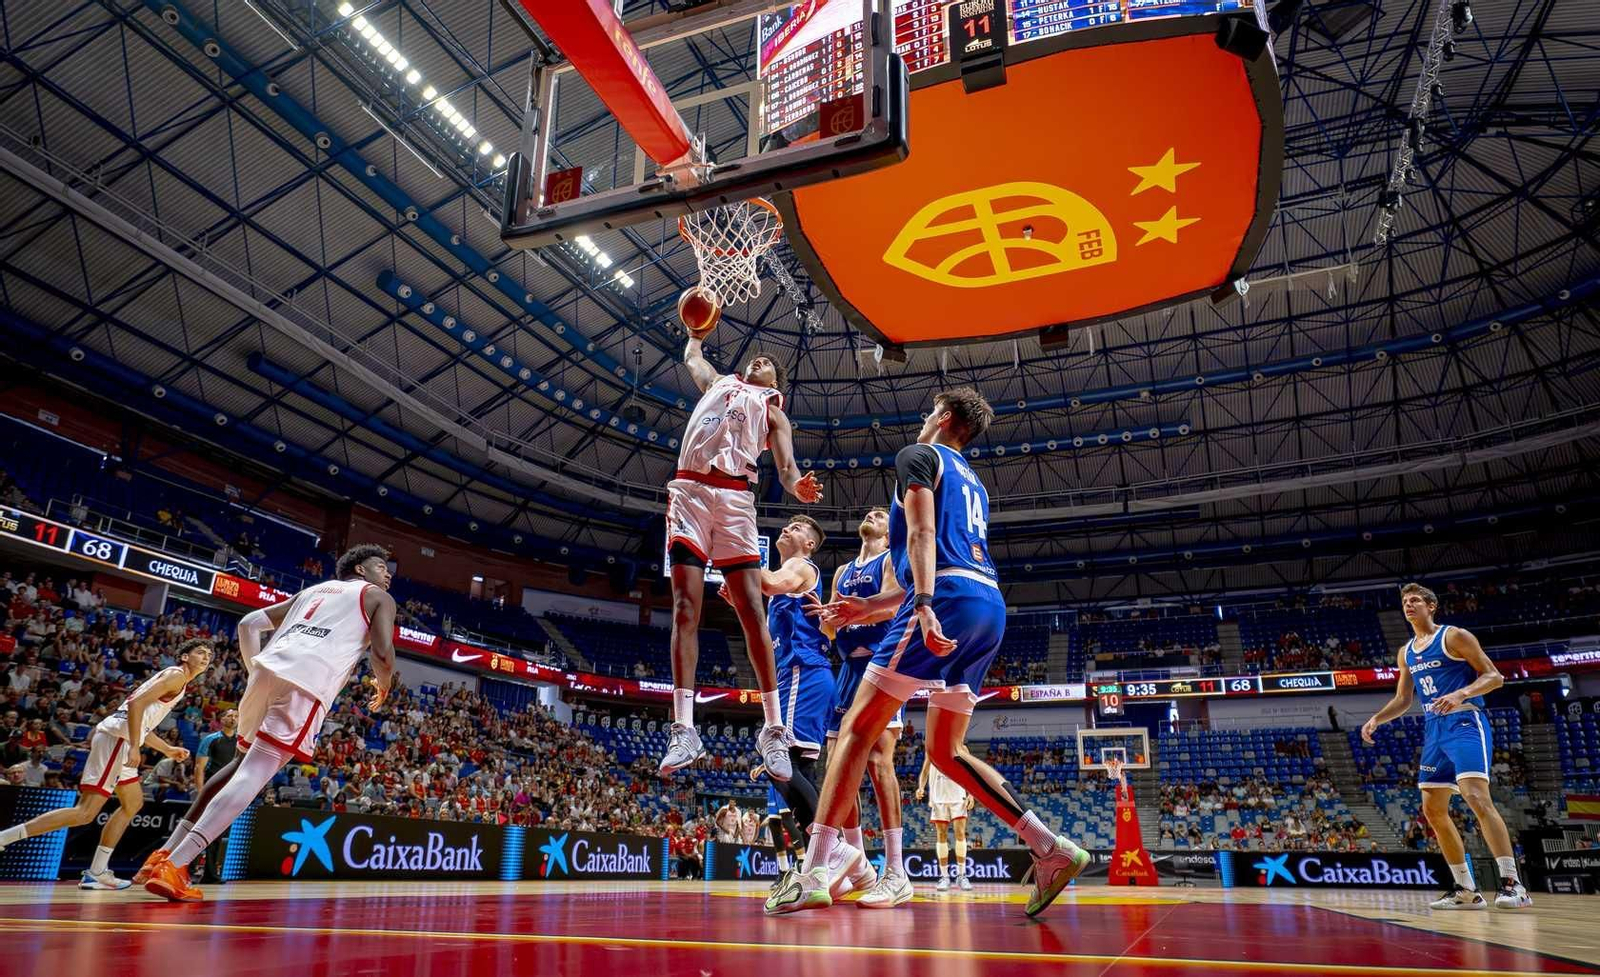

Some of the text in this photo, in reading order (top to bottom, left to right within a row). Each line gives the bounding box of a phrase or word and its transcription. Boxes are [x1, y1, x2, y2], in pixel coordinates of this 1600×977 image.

[761, 15, 784, 42] Bank
[774, 11, 806, 47] IBERIA
[963, 15, 990, 38] 11
[1038, 10, 1074, 24] PETERKA
[965, 41, 992, 53] LOTUS
[1077, 229, 1104, 261] FEB
[962, 483, 988, 540] 14
[34, 522, 59, 545] 11
[83, 540, 112, 560] 68
[148, 560, 199, 585] CHEQUIA
[1030, 689, 1063, 699] ESPAÑA
[1127, 684, 1157, 696] 9:35
[1200, 681, 1215, 693] 11
[1232, 679, 1251, 692] 68
[1280, 676, 1322, 688] CHEQUIA
[1419, 675, 1438, 696] 32
[1101, 695, 1119, 706] 10
[97, 811, 164, 828] eesa
[343, 826, 483, 871] CaixaBank
[571, 839, 651, 873] CaixaBank
[752, 851, 793, 875] Caixa
[904, 855, 1011, 878] CaiaBank
[1299, 858, 1439, 885] CaixaBank
